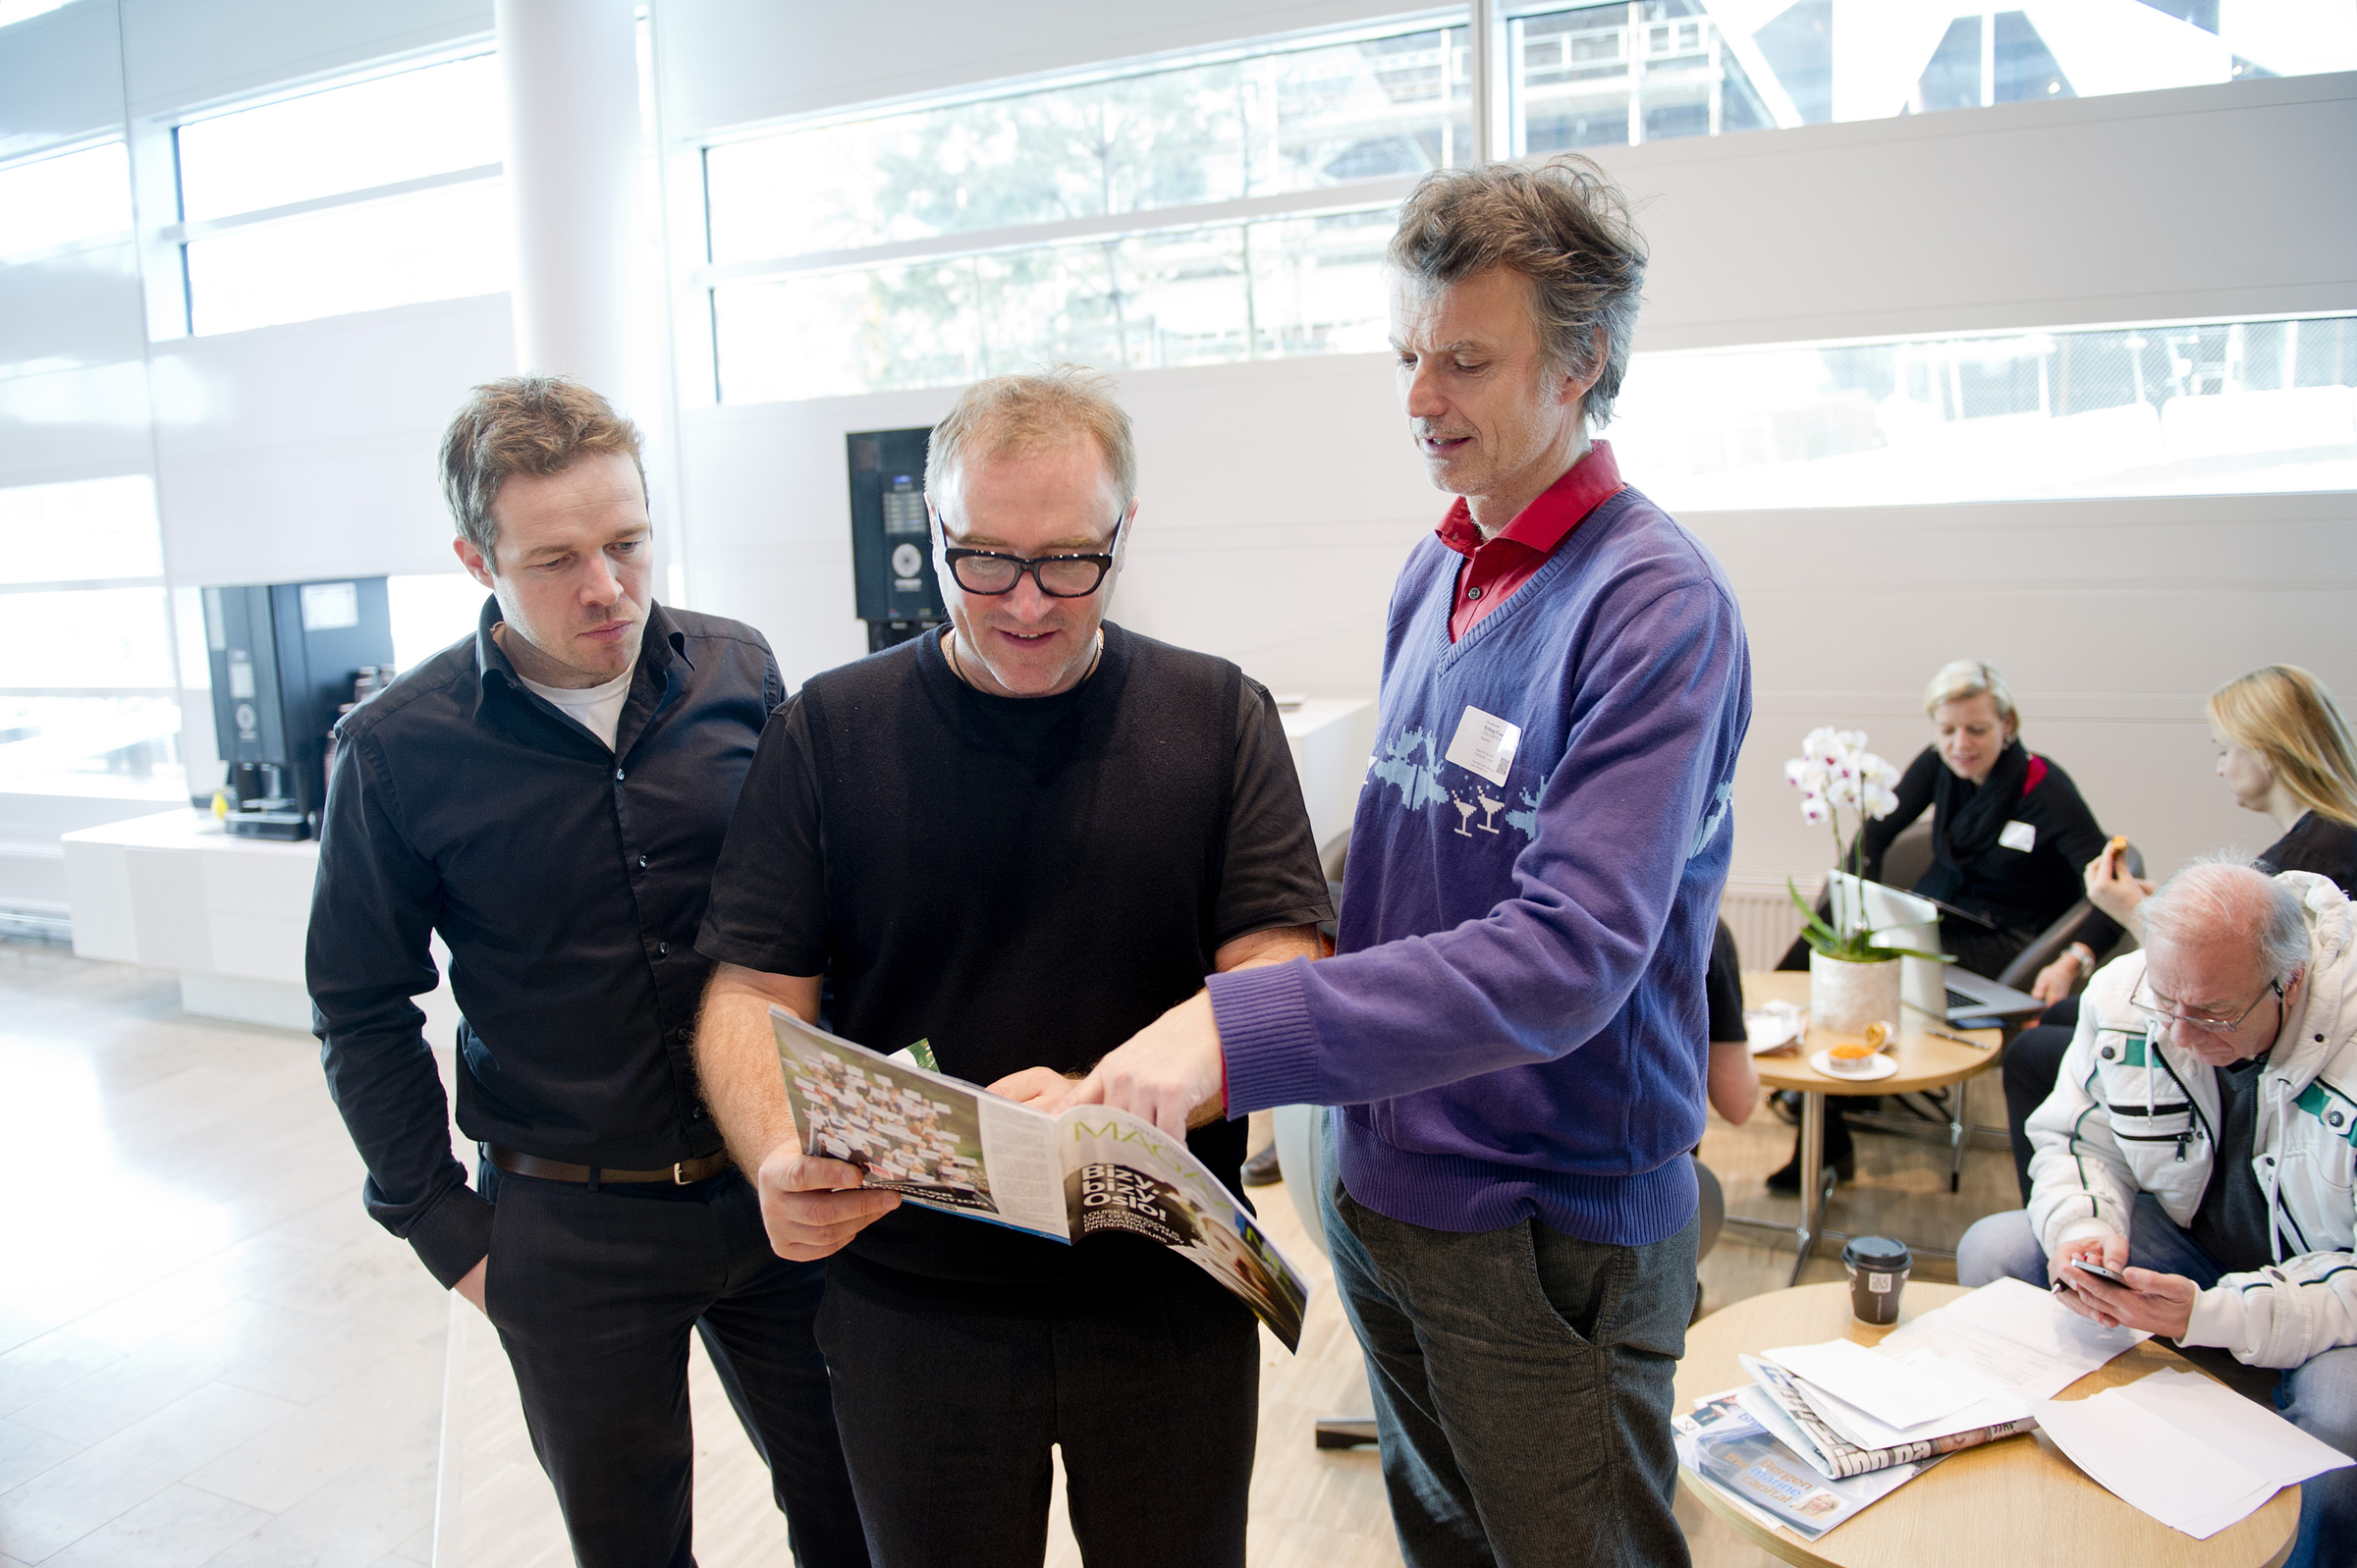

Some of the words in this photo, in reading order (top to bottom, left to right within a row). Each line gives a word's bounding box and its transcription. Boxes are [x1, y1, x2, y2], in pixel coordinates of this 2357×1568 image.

[1082, 1178, 1157, 1204] bizy
[1083, 1192, 1167, 1222] Oslo!
[1749, 1467, 1802, 1497] marine
[1760, 1459, 1813, 1490] Bergen
[1741, 1476, 1794, 1504] capital
